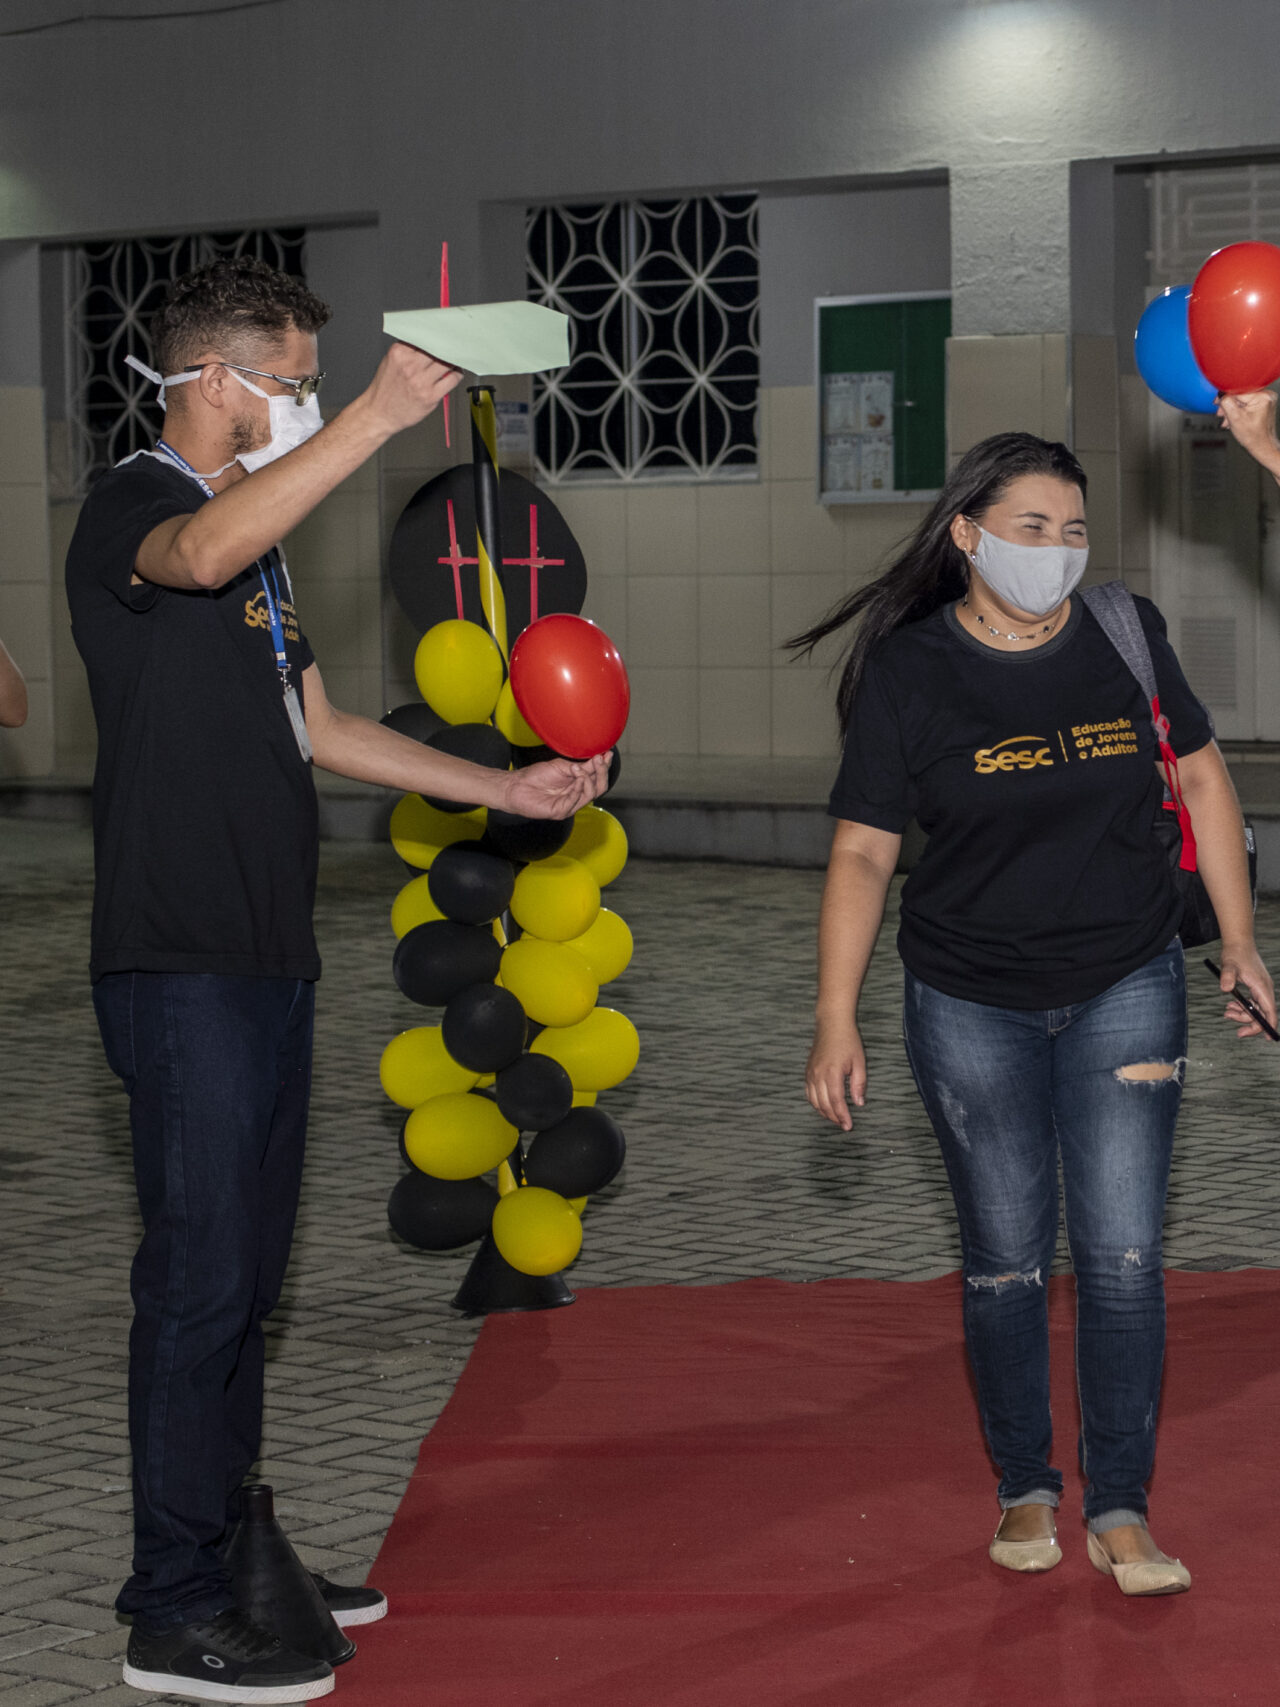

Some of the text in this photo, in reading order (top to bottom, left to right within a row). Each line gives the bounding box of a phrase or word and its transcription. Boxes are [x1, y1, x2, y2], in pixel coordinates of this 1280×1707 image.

[1071, 717, 1132, 738] Educação
[1075, 731, 1137, 748] de Jovens
[974, 746, 1054, 774] Sesc
[1078, 742, 1138, 760] e Adultos
